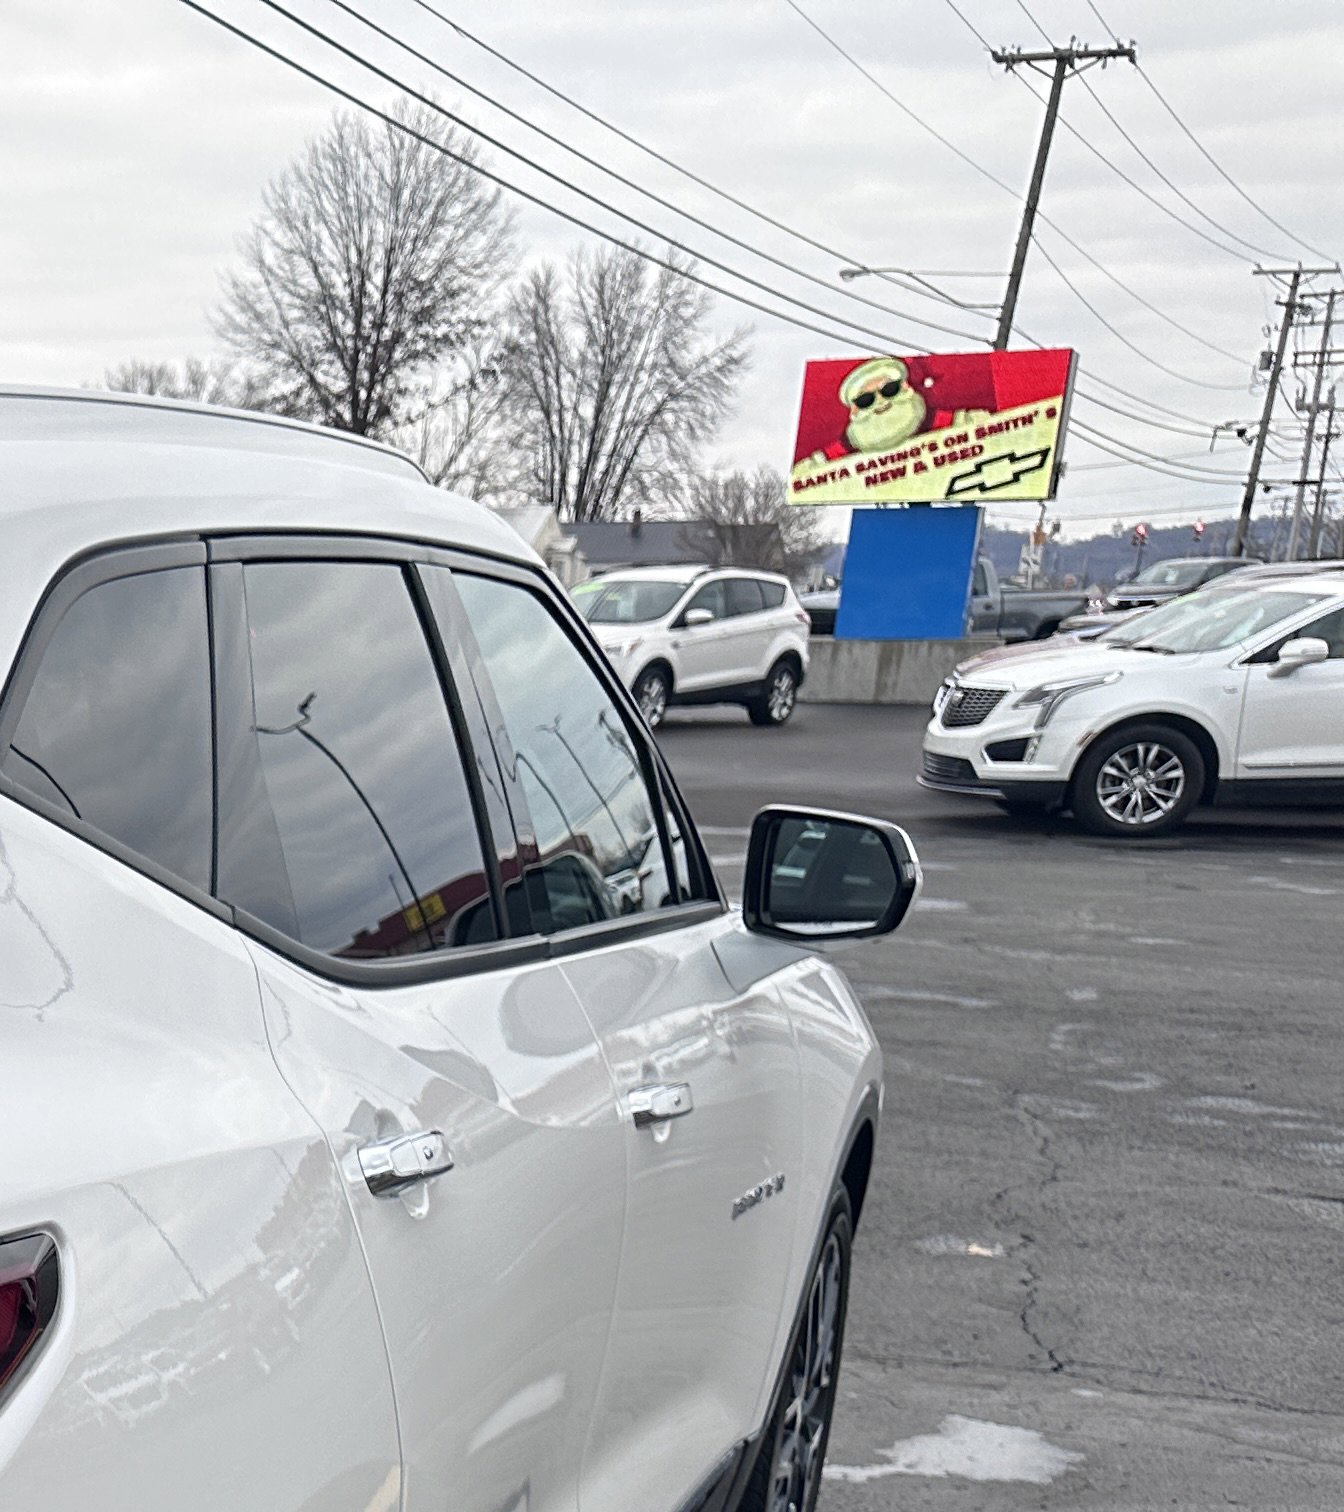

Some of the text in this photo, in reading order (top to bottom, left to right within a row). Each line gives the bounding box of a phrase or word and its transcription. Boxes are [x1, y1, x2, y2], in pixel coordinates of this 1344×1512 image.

[792, 467, 850, 493] SANTA
[854, 441, 938, 475] SAVING'S
[943, 432, 968, 448] ON
[864, 444, 984, 488] NEW & USED
